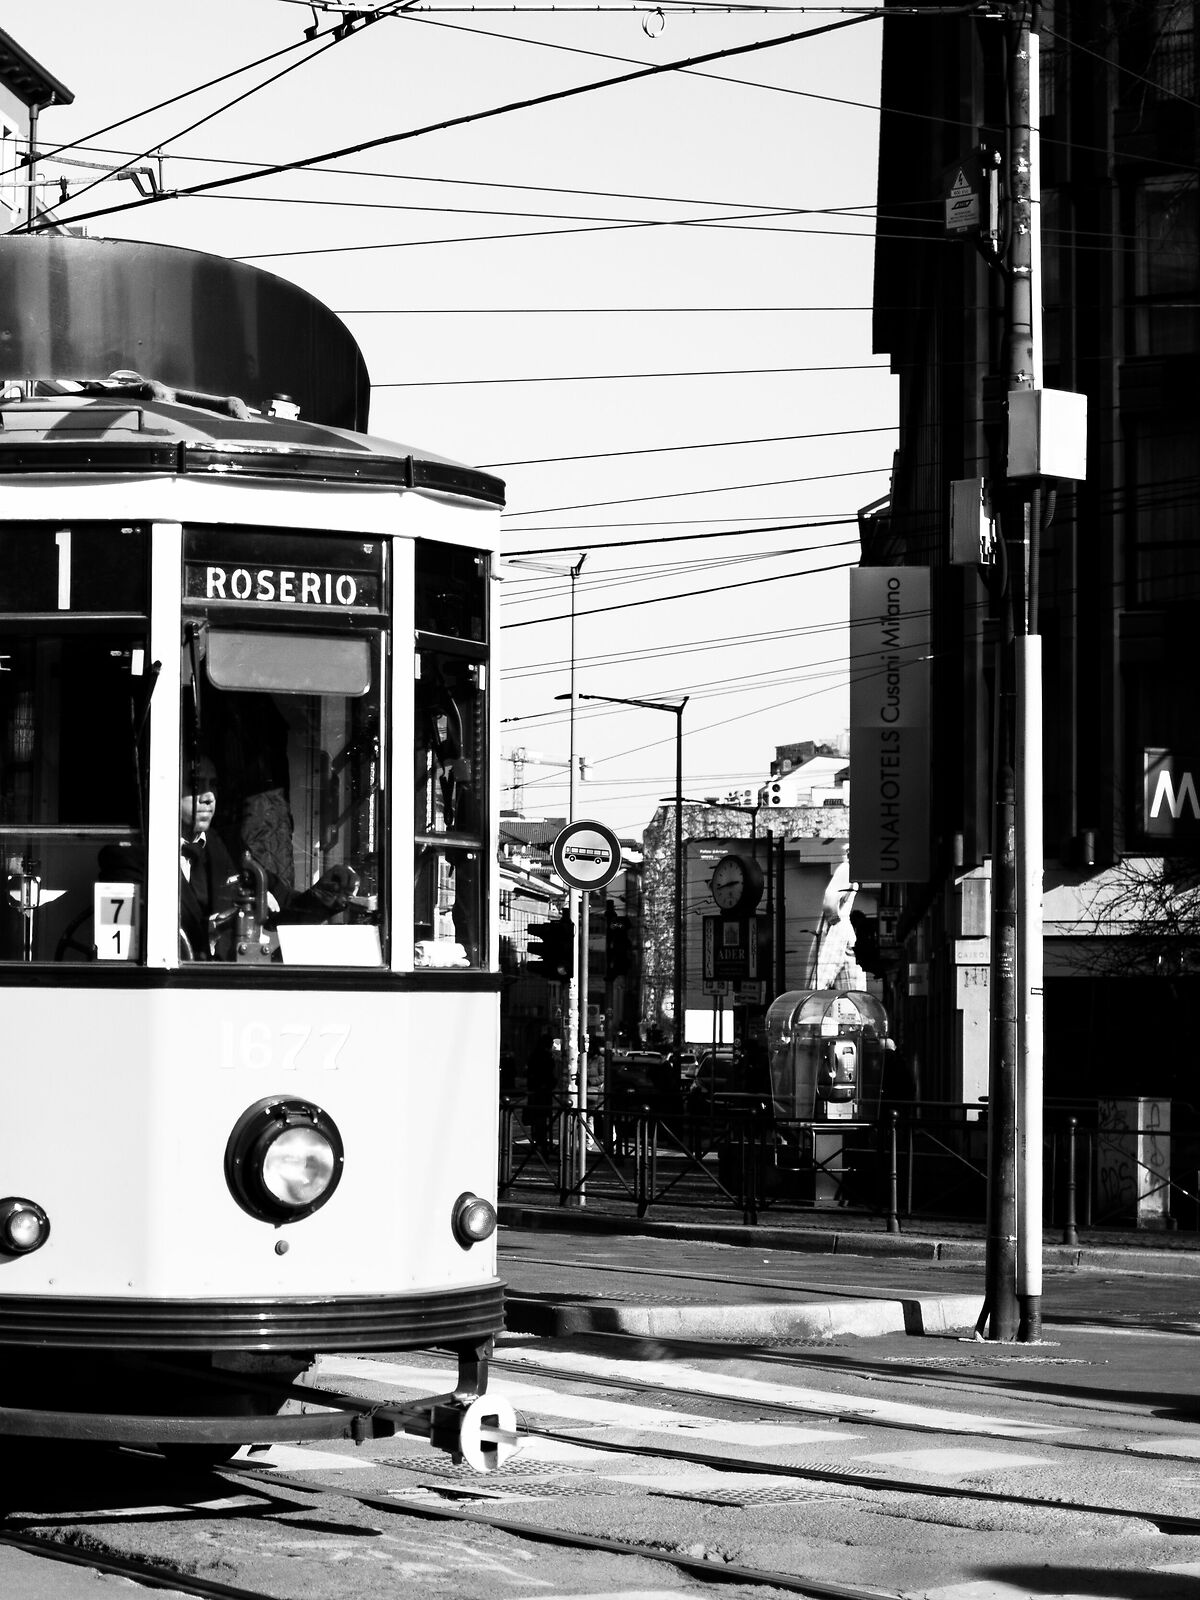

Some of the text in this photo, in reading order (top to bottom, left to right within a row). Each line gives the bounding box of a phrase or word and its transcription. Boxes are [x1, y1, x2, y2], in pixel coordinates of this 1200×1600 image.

[55, 530, 71, 609] 1
[206, 566, 357, 605] ROSERIO
[881, 577, 900, 872] UNAHOTELS Cusani Milano
[1150, 770, 1200, 819] M
[111, 899, 124, 924] 7
[112, 930, 120, 954] 1
[220, 1021, 352, 1071] 1677
